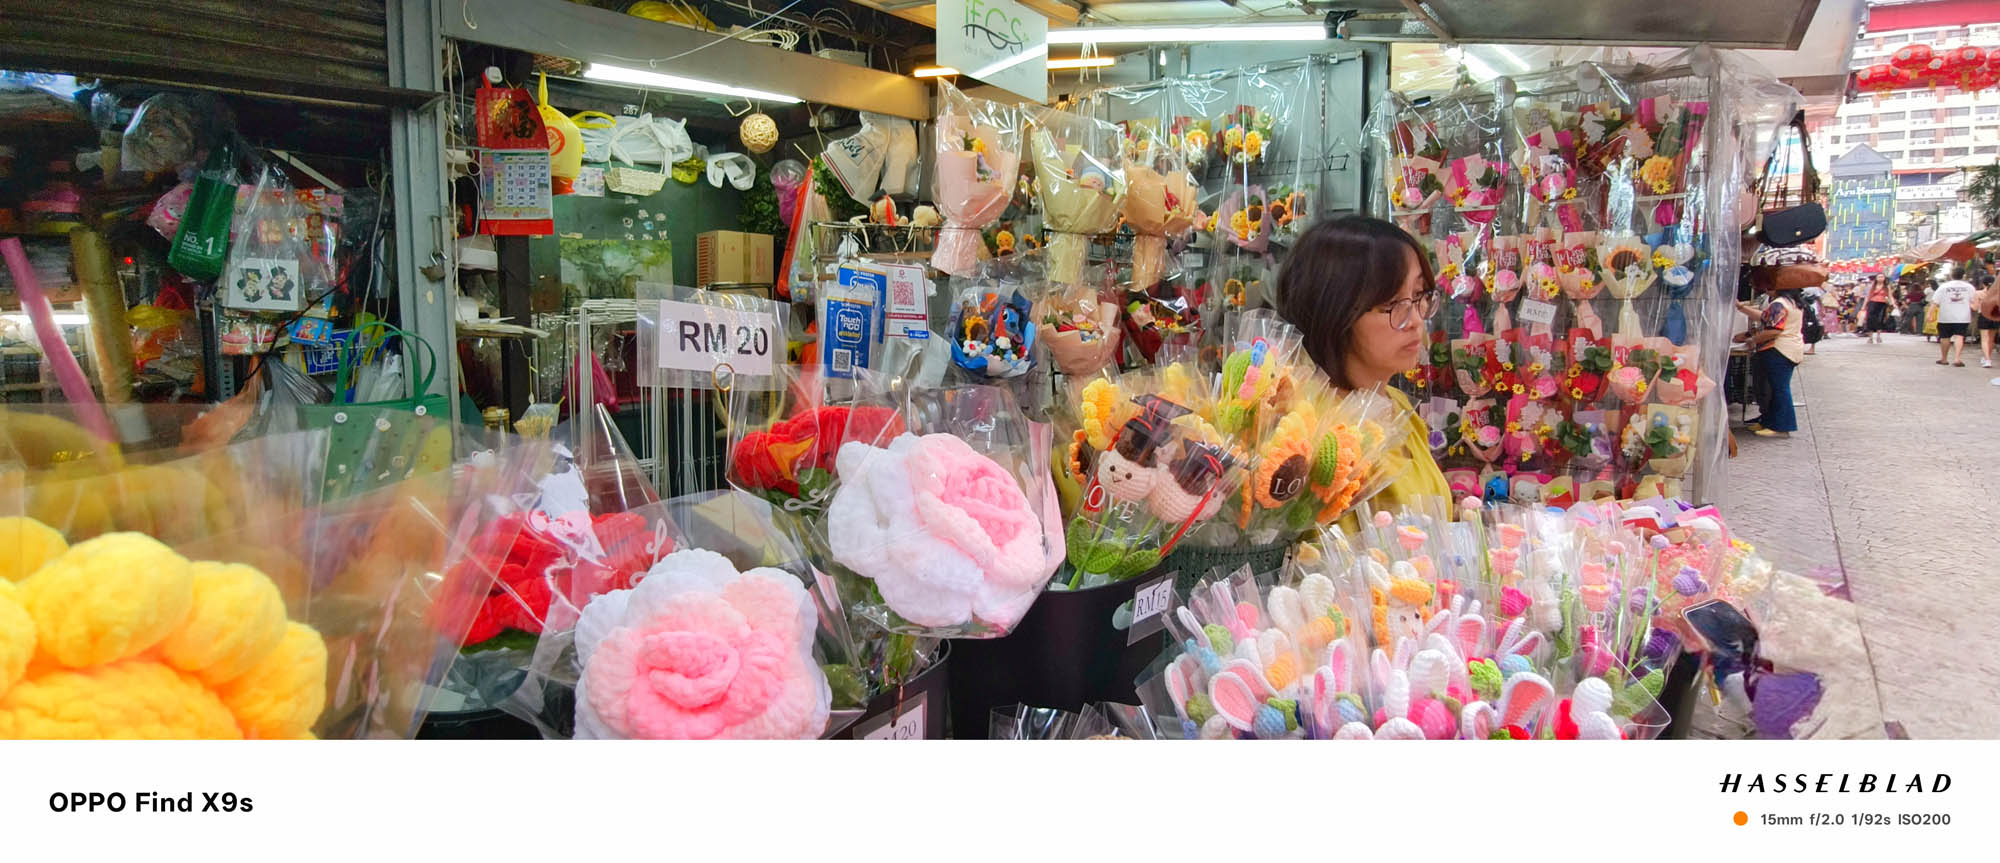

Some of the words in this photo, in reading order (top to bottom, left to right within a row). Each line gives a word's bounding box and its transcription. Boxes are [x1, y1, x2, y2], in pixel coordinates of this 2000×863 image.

[205, 236, 215, 256] 1
[680, 321, 728, 354] RM
[736, 325, 768, 356] 20
[882, 719, 917, 740] 20
